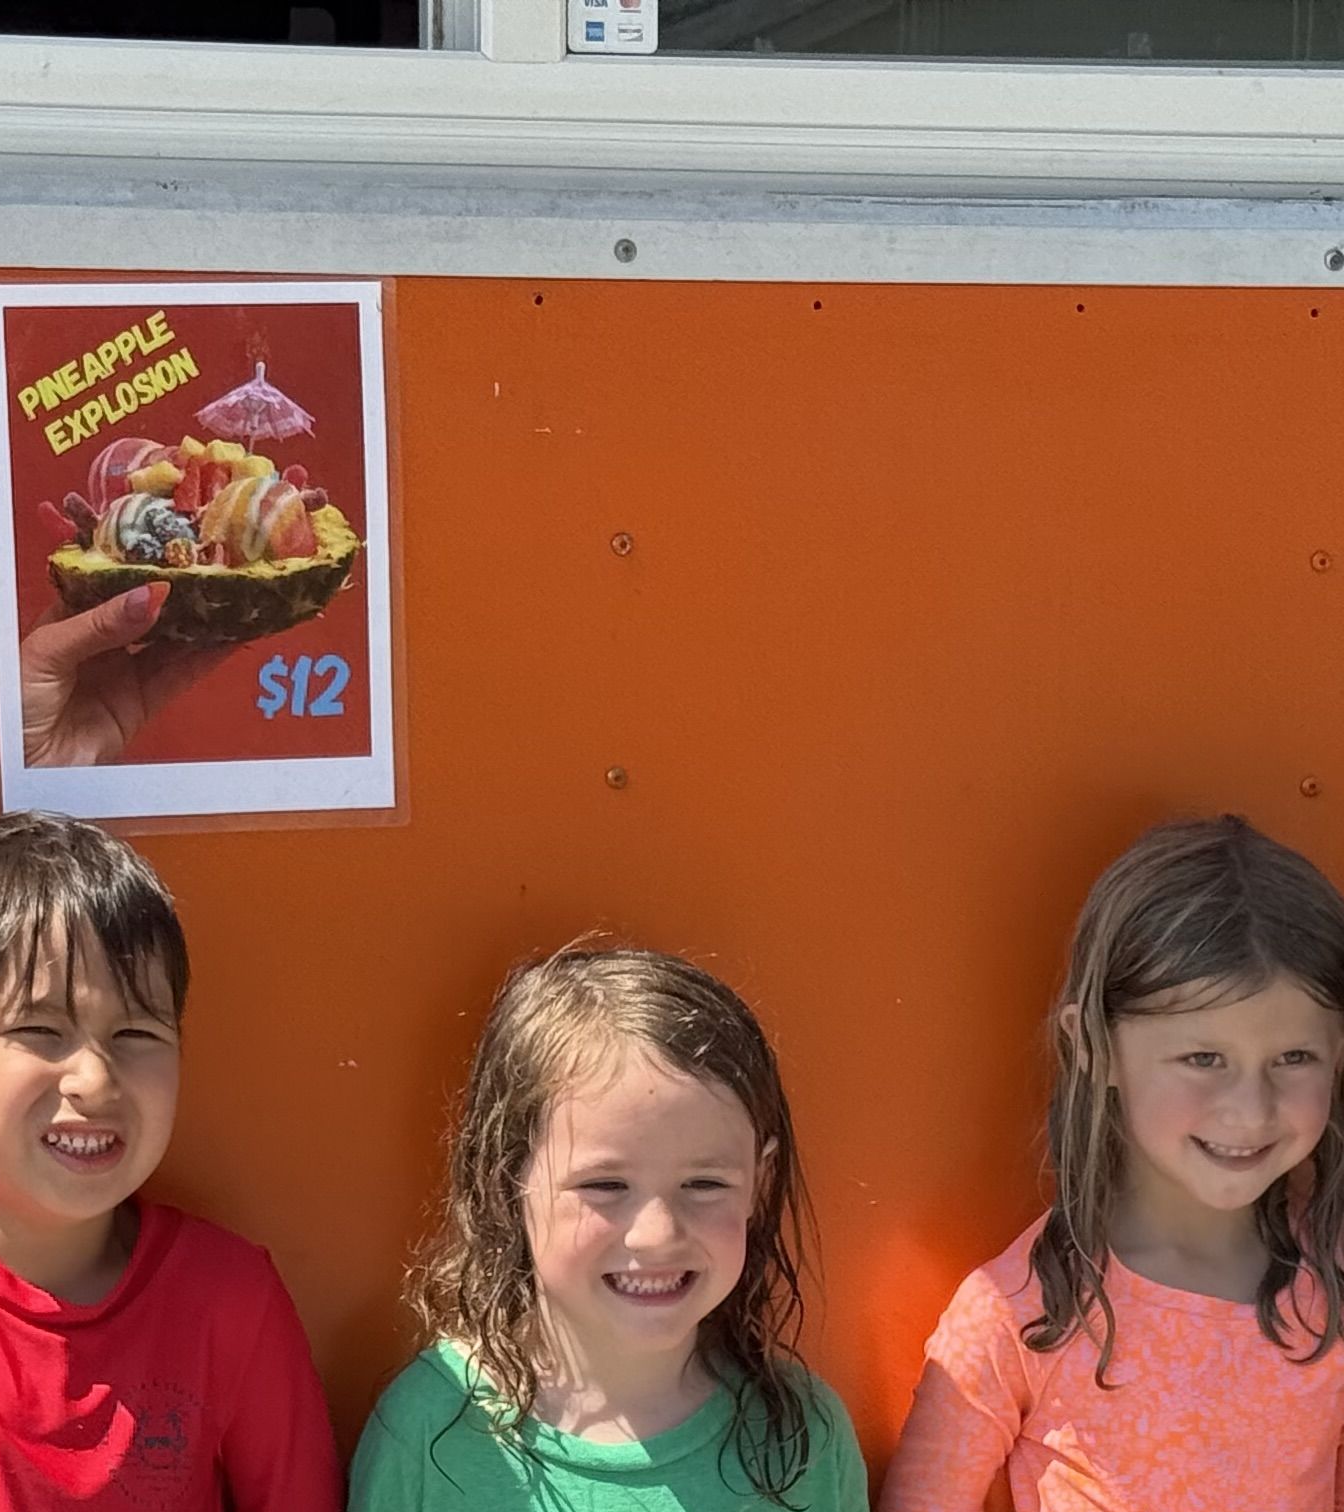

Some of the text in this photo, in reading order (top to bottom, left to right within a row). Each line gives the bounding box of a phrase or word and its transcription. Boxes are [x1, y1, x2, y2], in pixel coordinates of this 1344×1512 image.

[17, 309, 176, 421] PINEAPPLE
[44, 347, 200, 456] EXPLOSION
[257, 654, 351, 720] $12
